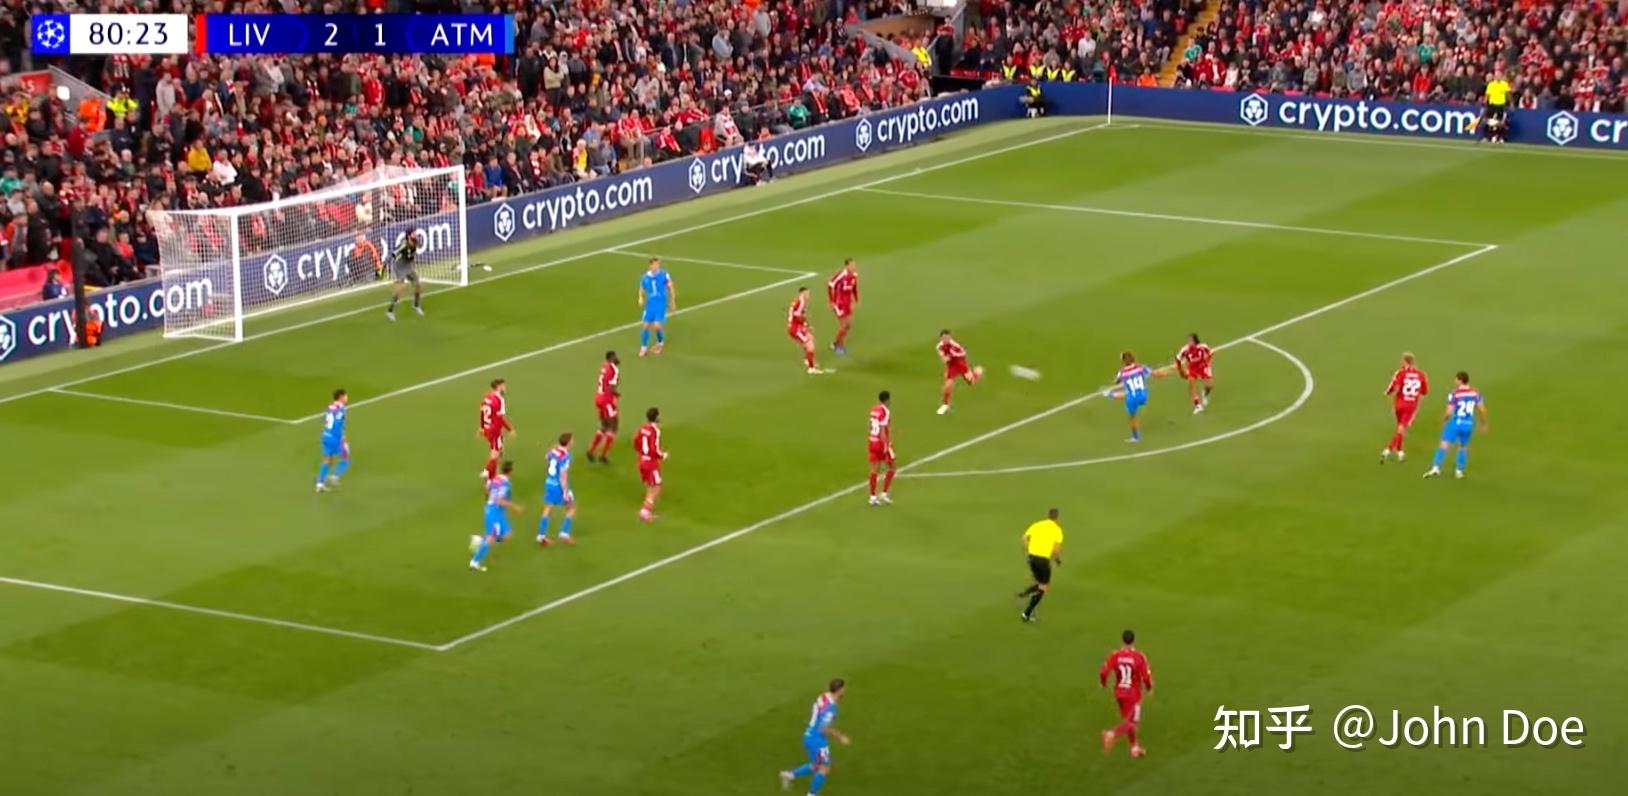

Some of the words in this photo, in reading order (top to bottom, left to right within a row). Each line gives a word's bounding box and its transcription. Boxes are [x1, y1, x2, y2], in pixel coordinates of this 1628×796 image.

[876, 97, 979, 143] crypto.com
[1279, 100, 1476, 134] crypto.com
[711, 134, 825, 184] cryo.com
[522, 176, 653, 230] crypto.com
[1126, 376, 1145, 397] 14
[1457, 400, 1475, 416] 24
